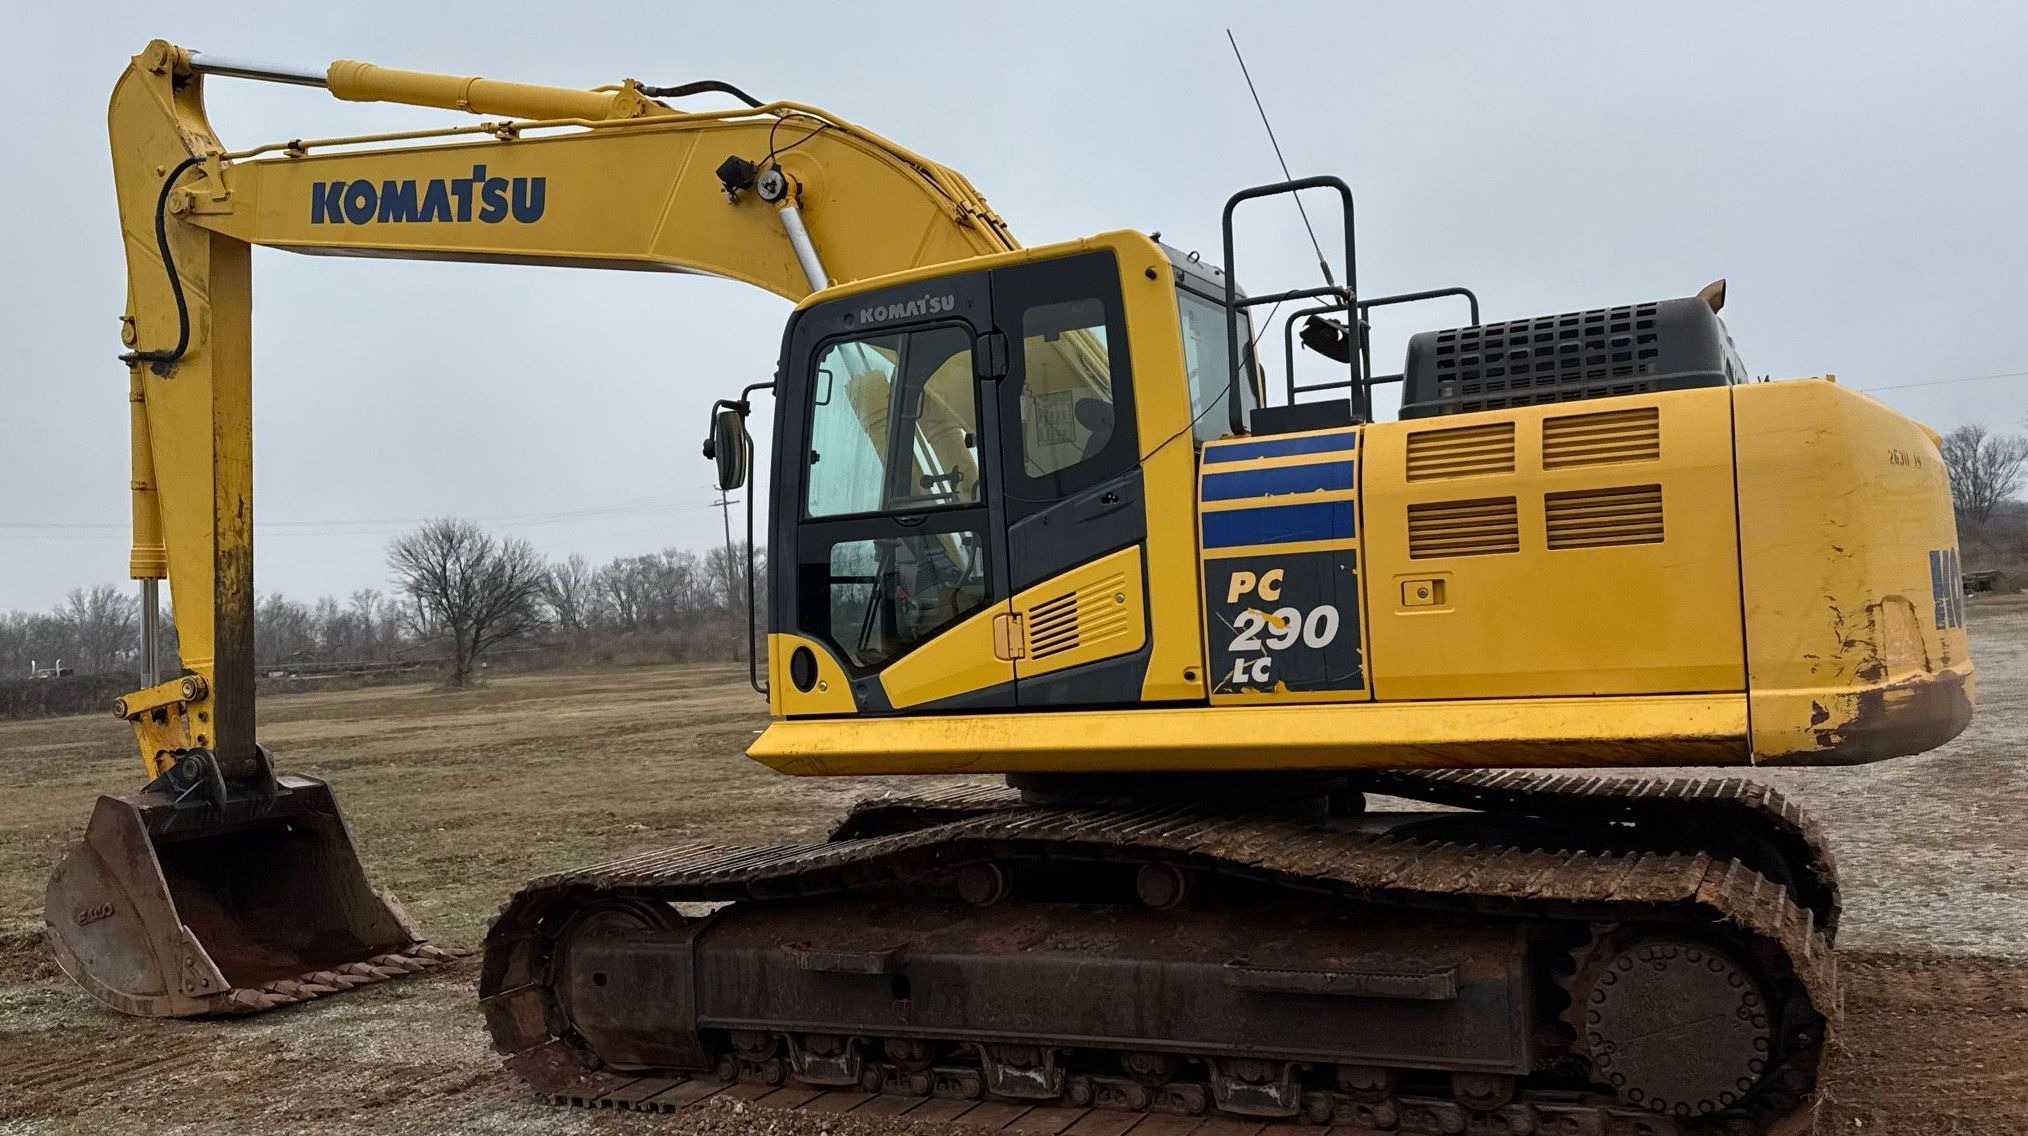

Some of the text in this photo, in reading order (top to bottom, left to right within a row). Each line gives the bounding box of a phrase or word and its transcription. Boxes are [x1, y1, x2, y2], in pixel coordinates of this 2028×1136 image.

[311, 164, 547, 225] KOMATSU
[860, 294, 955, 324] KOMATSU
[1227, 568, 1285, 604] PC
[1228, 604, 1340, 651] 290
[1232, 656, 1273, 684] LC
